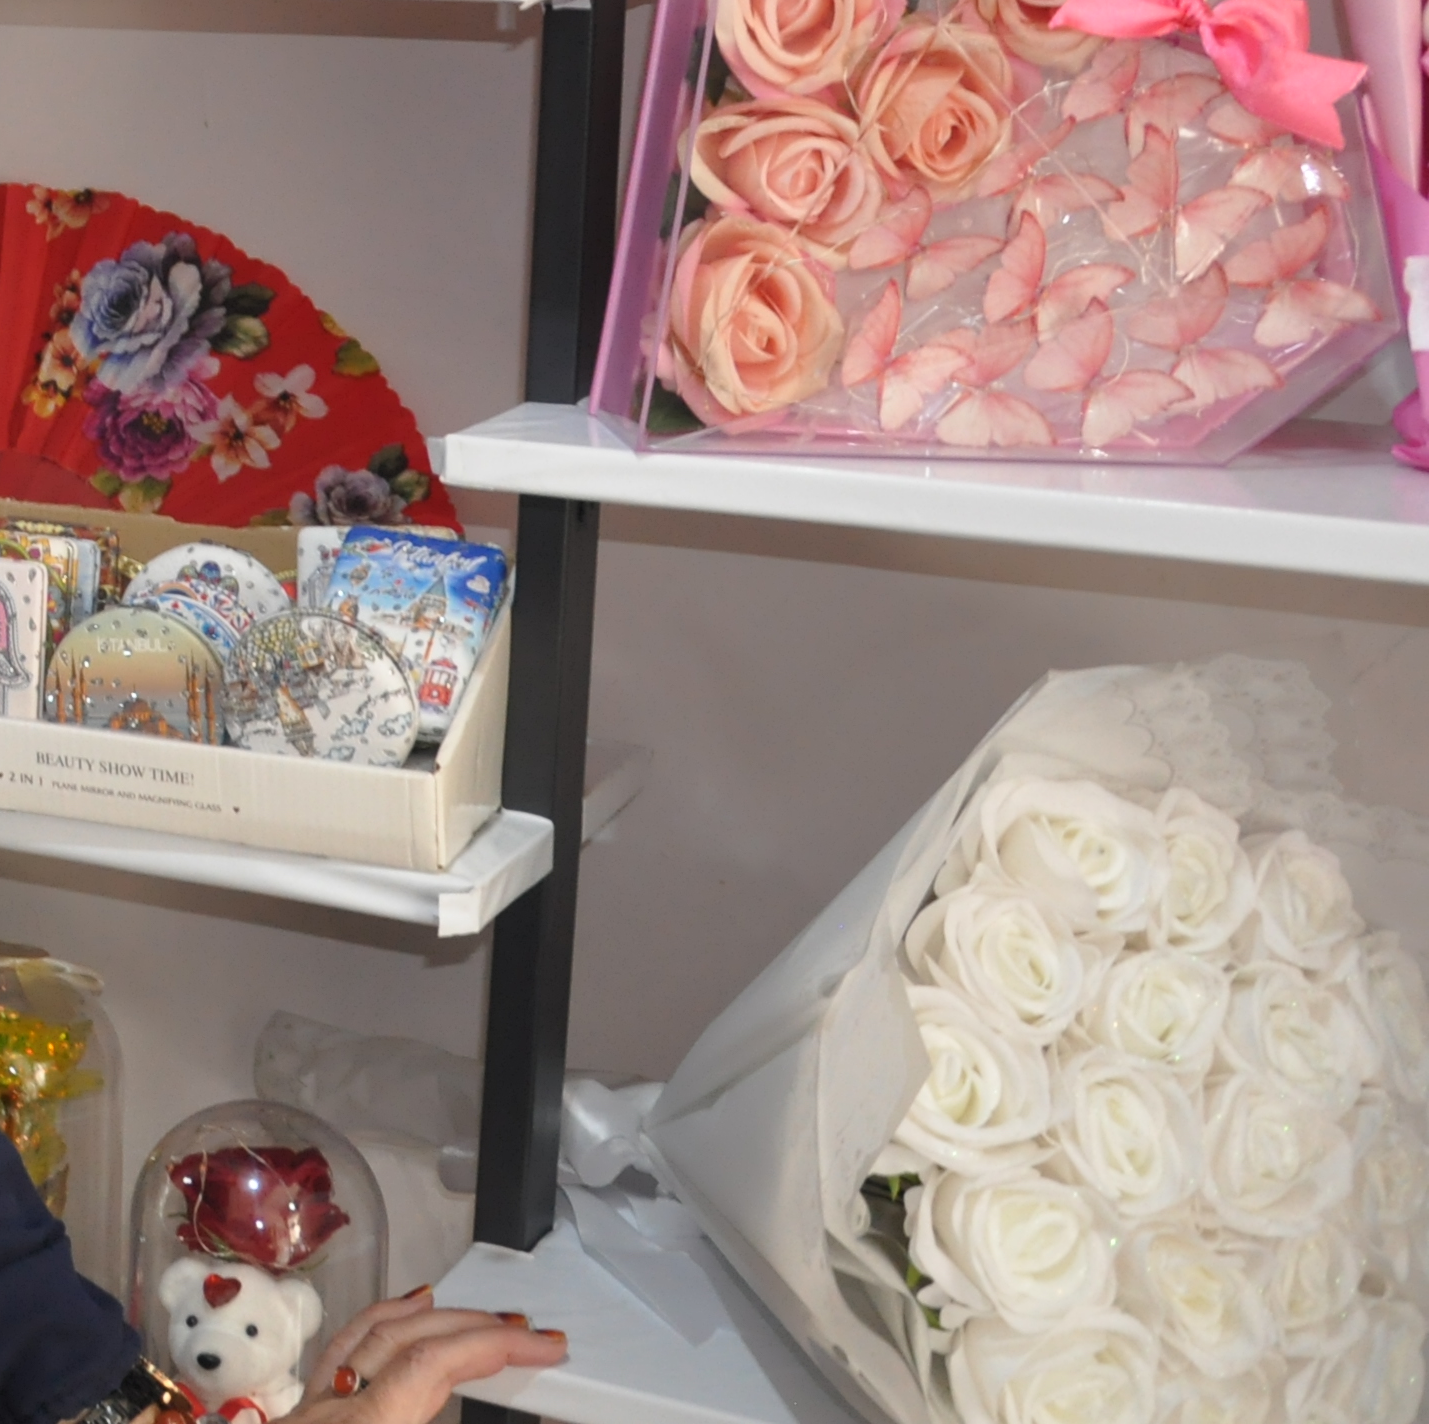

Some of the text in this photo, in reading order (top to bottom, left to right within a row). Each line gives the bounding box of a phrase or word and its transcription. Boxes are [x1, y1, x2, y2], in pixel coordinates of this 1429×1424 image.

[36, 751, 195, 787] BEAUTY SHOW TIME!
[9, 771, 17, 782] 2
[20, 773, 34, 785] IN
[52, 781, 78, 792] PLANE
[80, 785, 115, 797] MIRROR
[117, 789, 136, 800] AND
[138, 793, 193, 809] MAGNIFYING
[195, 801, 222, 813] GLASS
